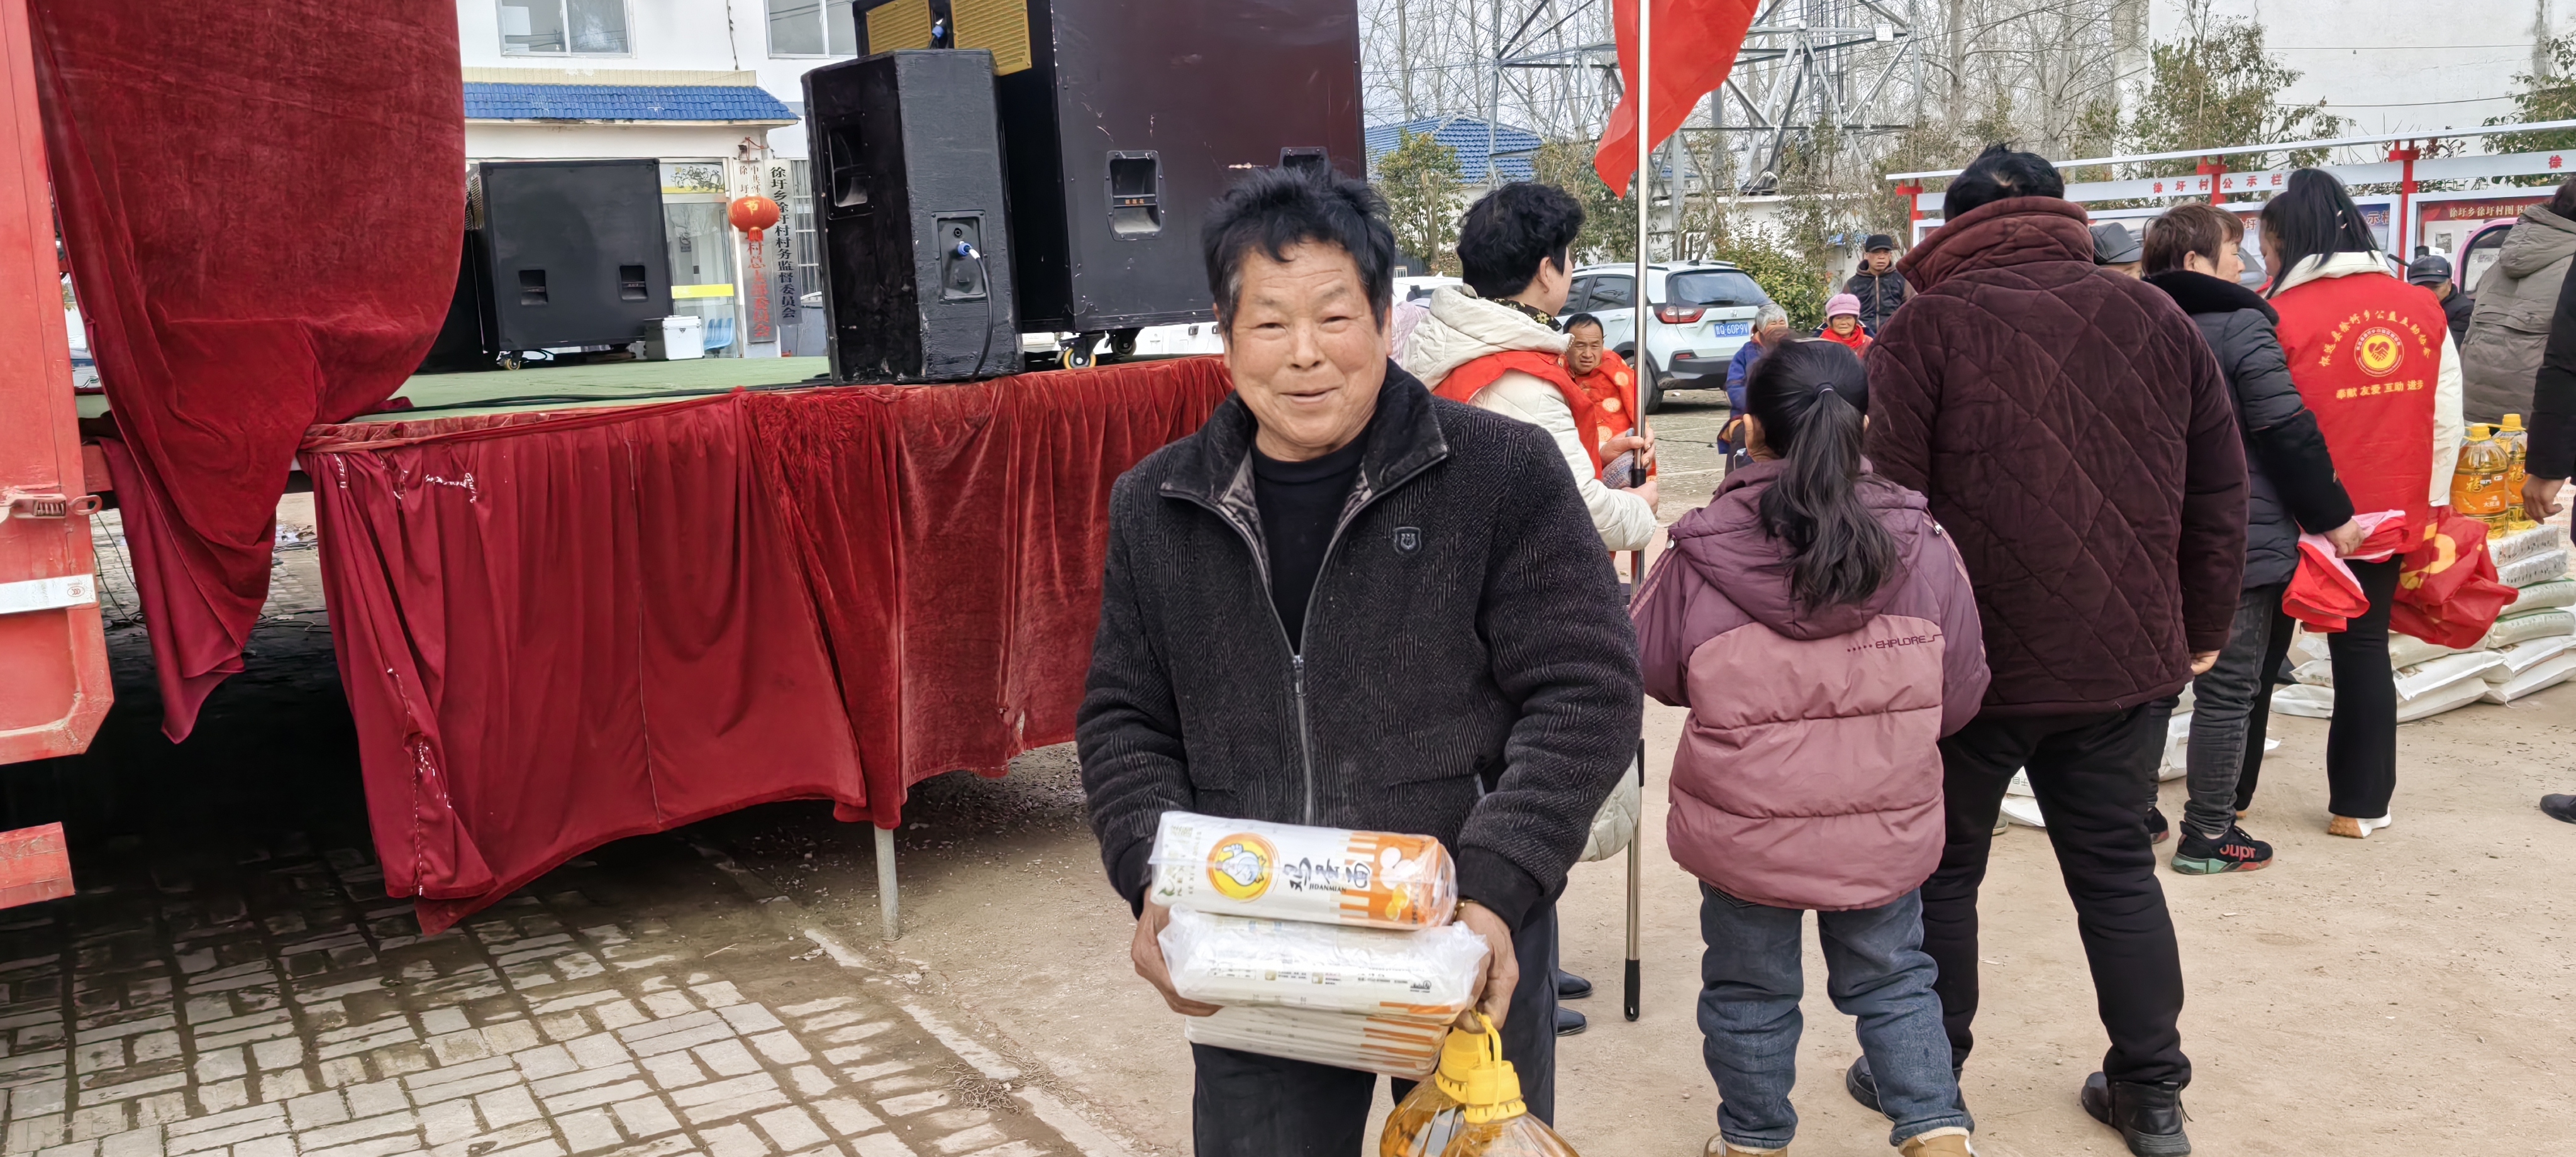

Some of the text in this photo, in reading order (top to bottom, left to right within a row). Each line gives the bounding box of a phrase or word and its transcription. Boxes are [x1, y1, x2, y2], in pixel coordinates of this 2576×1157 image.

[2549, 155, 2563, 169] 徐
[2153, 174, 2282, 194] 徐圩村公示栏
[2450, 204, 2528, 218] 徐圩乡徐圩村图书
[770, 166, 796, 318] 徐圩乡徐圩村村务监督委员会
[2336, 380, 2424, 399] 奉献 友爱 互助 进步
[1309, 883, 1347, 893] JIDANMIAN
